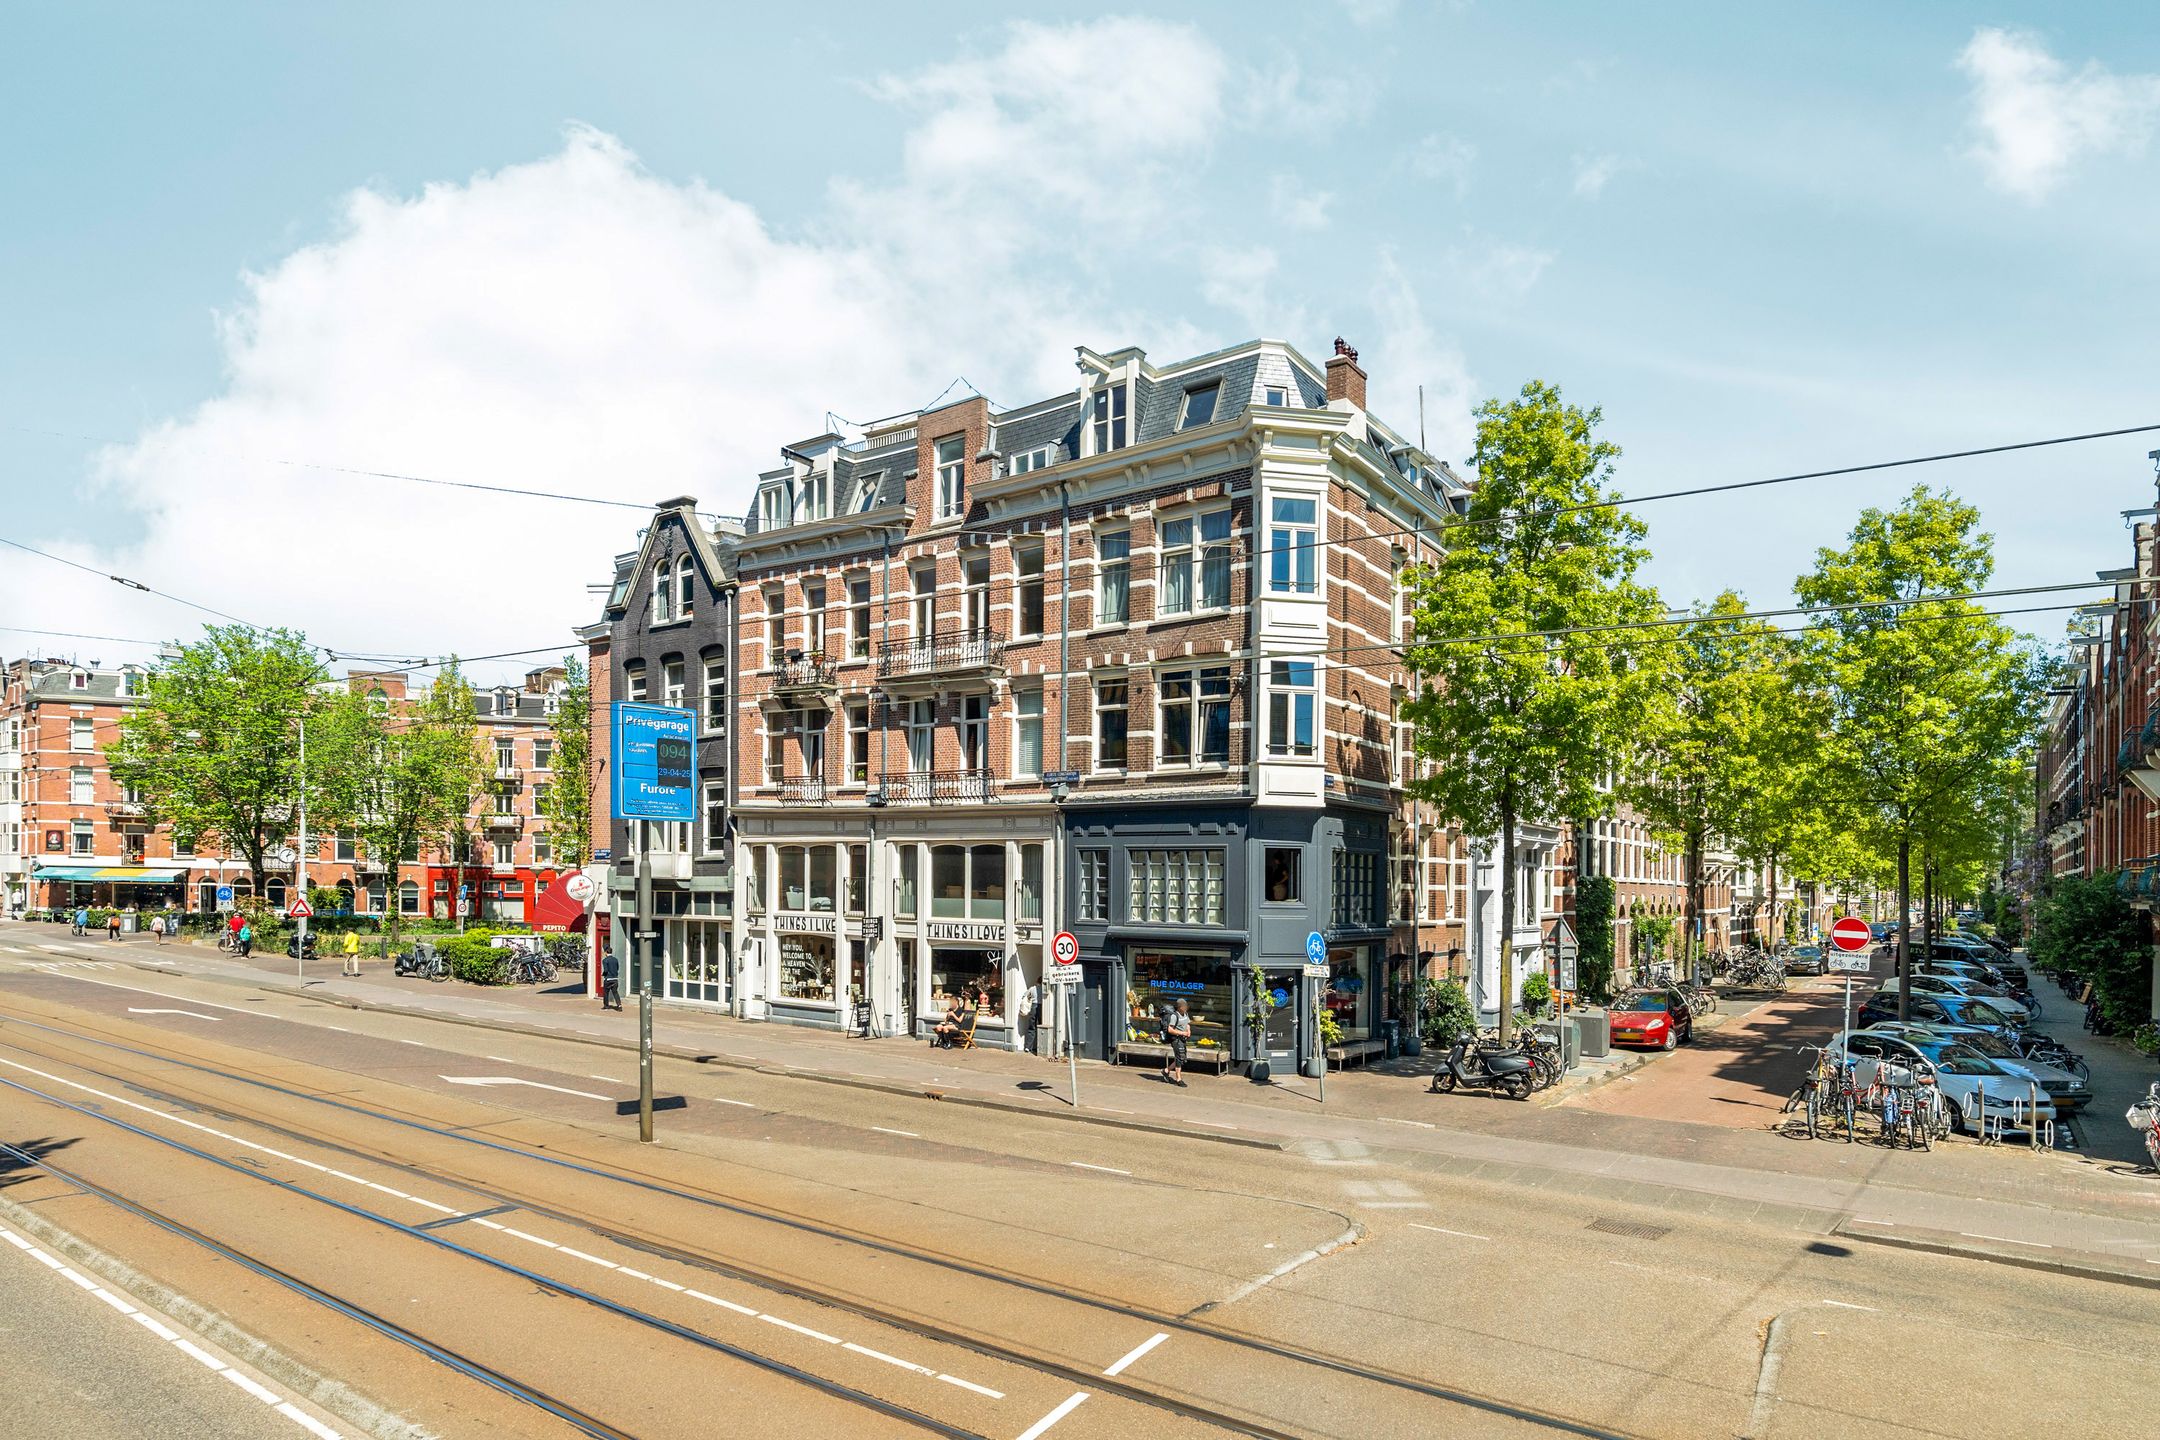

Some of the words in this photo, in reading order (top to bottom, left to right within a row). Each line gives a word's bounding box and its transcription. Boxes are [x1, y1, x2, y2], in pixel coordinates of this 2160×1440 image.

[625, 715, 689, 732] Privégarage
[660, 744, 689, 760] 094
[640, 783, 676, 795] Furore
[774, 916, 806, 930] THINGS
[815, 918, 836, 932] LIKE
[927, 924, 968, 939] THINGS
[977, 926, 1005, 941] LOVE
[782, 943, 791, 951] HEY
[1058, 942, 1073, 955] 30
[782, 952, 805, 960] WELCOME
[805, 952, 812, 960] TO
[1151, 980, 1168, 988] RUE
[1169, 980, 1205, 990] D'ALGER
